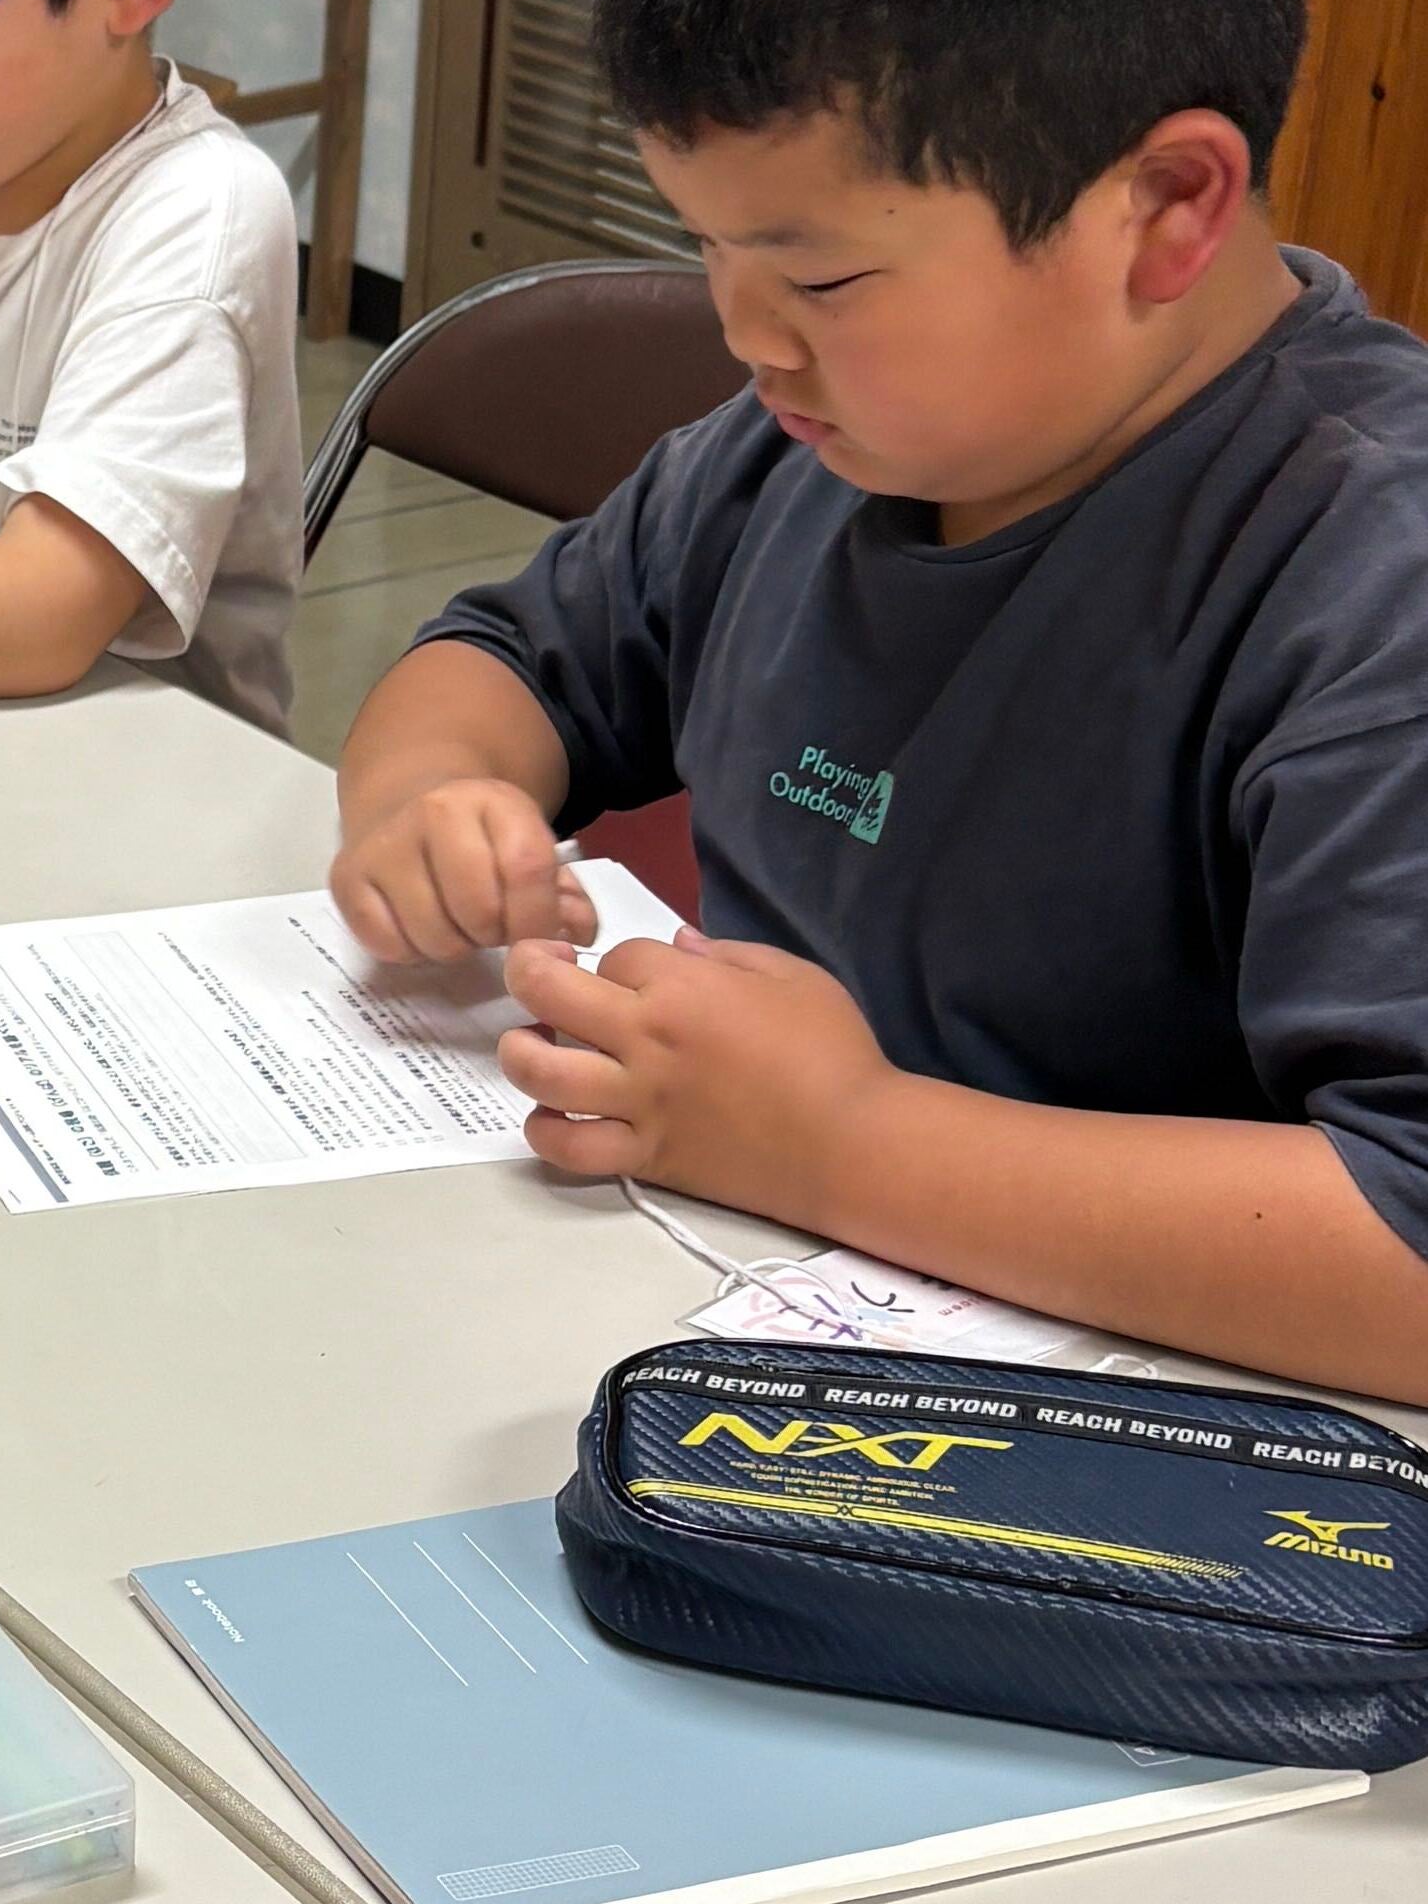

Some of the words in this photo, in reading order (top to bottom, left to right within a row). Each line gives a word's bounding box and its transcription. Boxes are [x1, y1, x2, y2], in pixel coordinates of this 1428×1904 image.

[798, 745, 874, 801] Playing
[622, 1365, 703, 1389] REACH
[705, 1374, 806, 1400] BEYOND
[824, 1387, 910, 1410] REACH
[914, 1394, 1017, 1419] BEYOND
[1036, 1407, 1122, 1434] REACH
[1128, 1421, 1233, 1451] BEYOND
[1252, 1440, 1342, 1469] REACH
